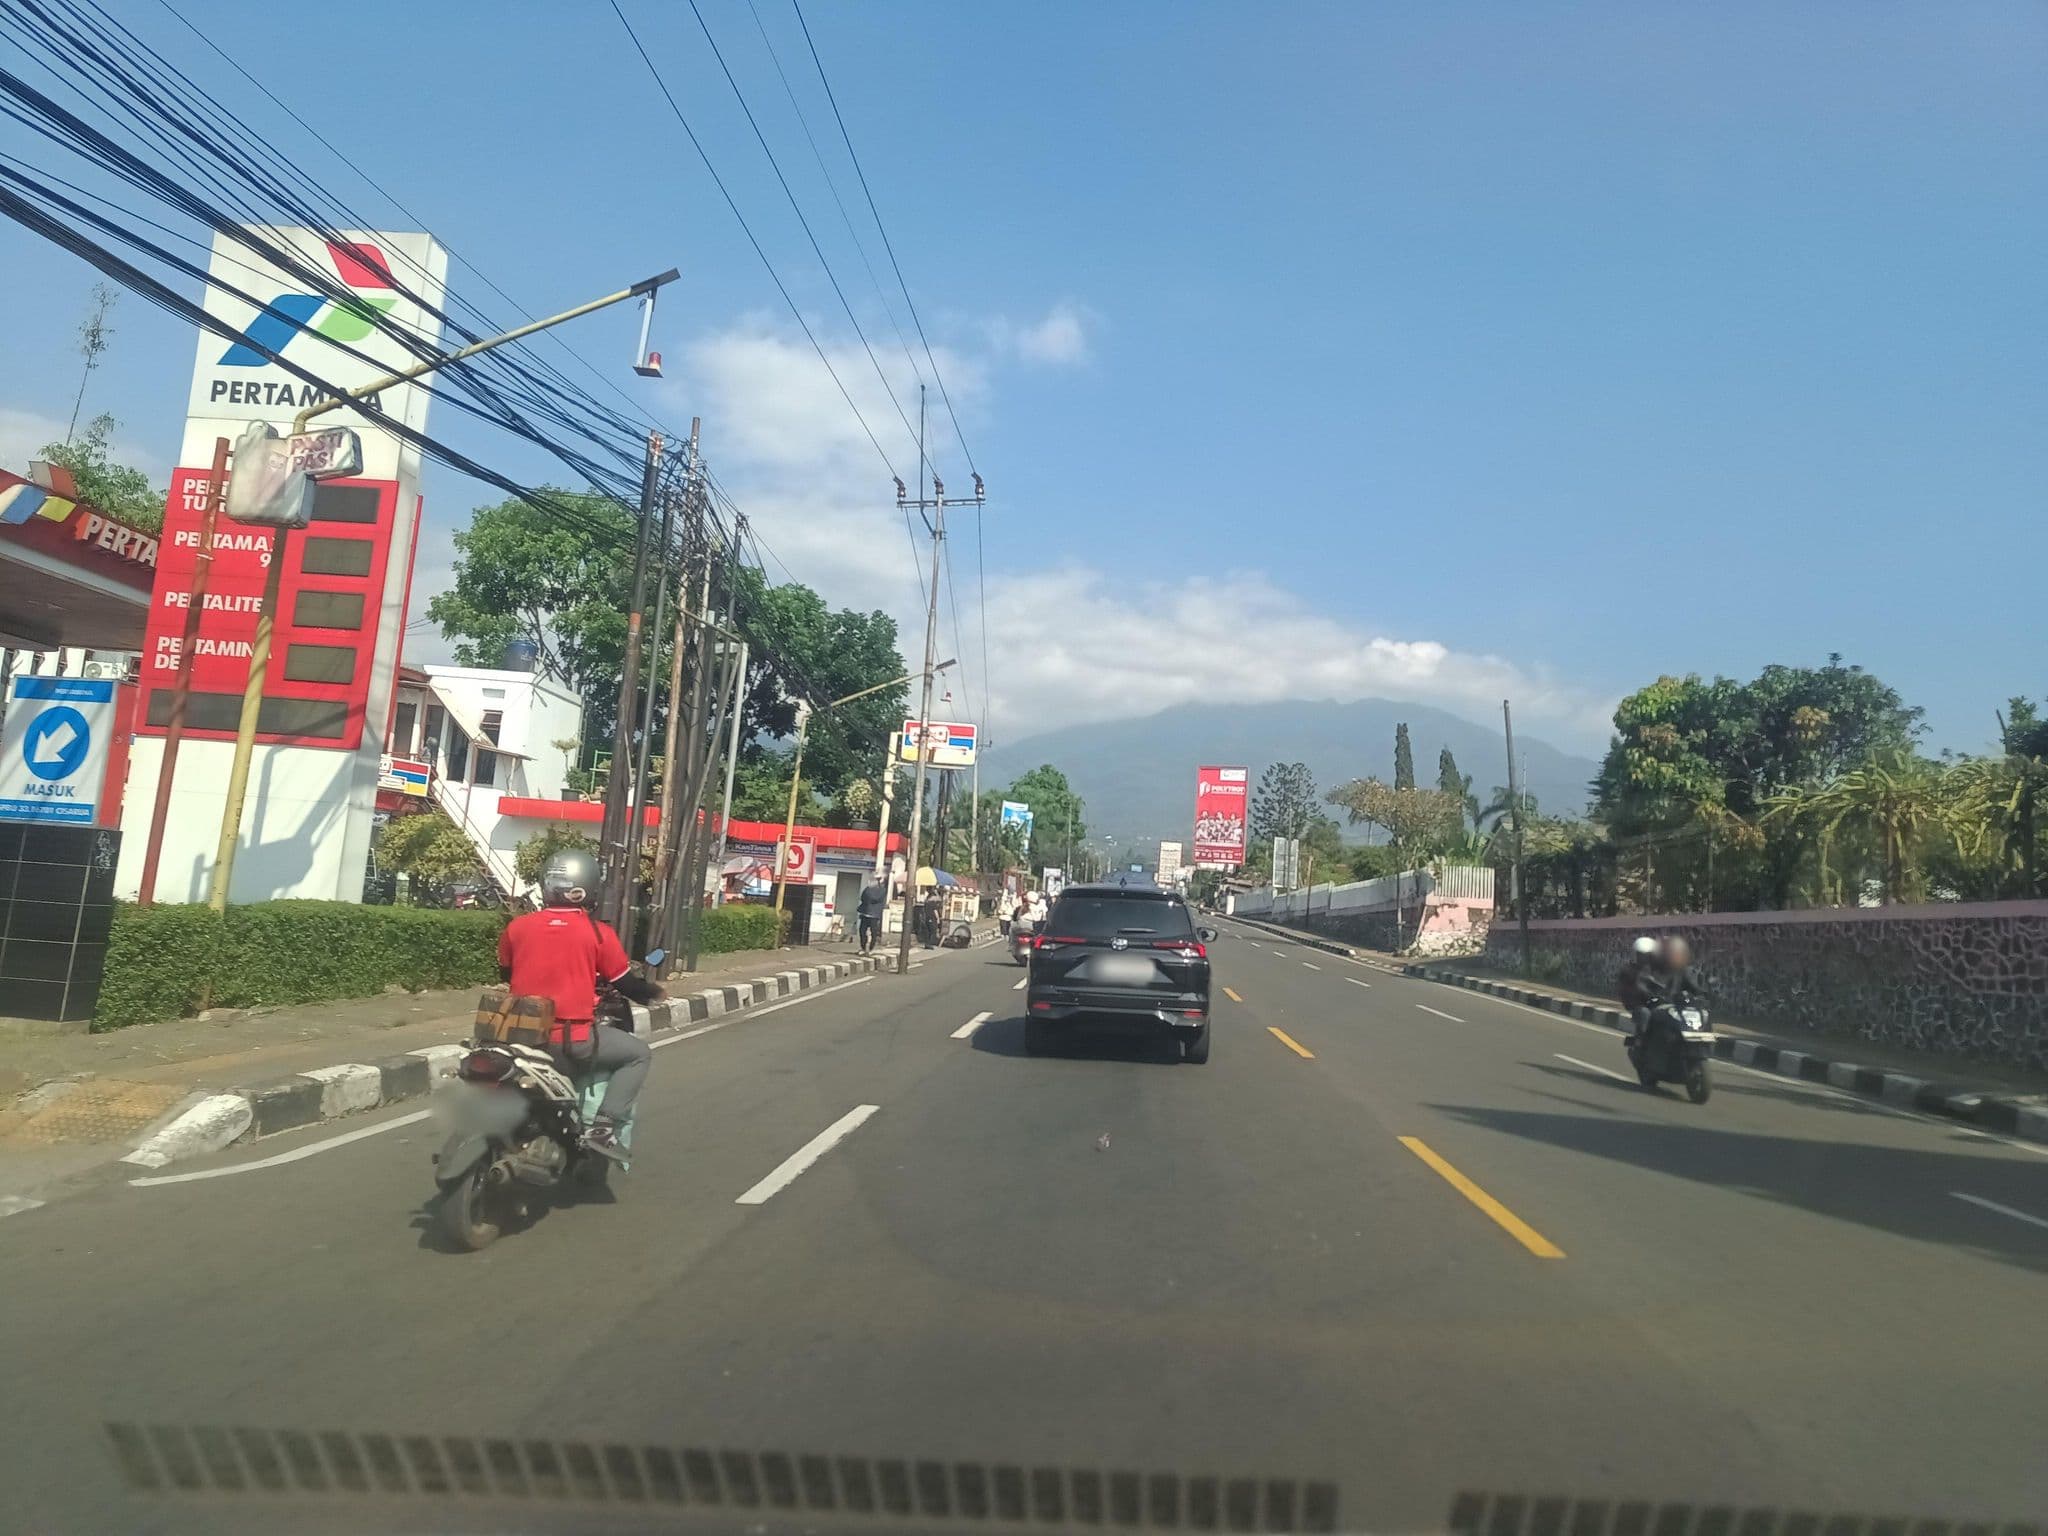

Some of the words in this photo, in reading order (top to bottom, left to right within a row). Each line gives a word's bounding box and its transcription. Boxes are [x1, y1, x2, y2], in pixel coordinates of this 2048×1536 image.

[210, 379, 384, 412] PERTAMA
[174, 530, 276, 553] PETAMA
[163, 590, 264, 614] PETALITE
[156, 635, 273, 660] PETAMIN
[153, 652, 195, 672] DE
[23, 783, 76, 798] MASUK
